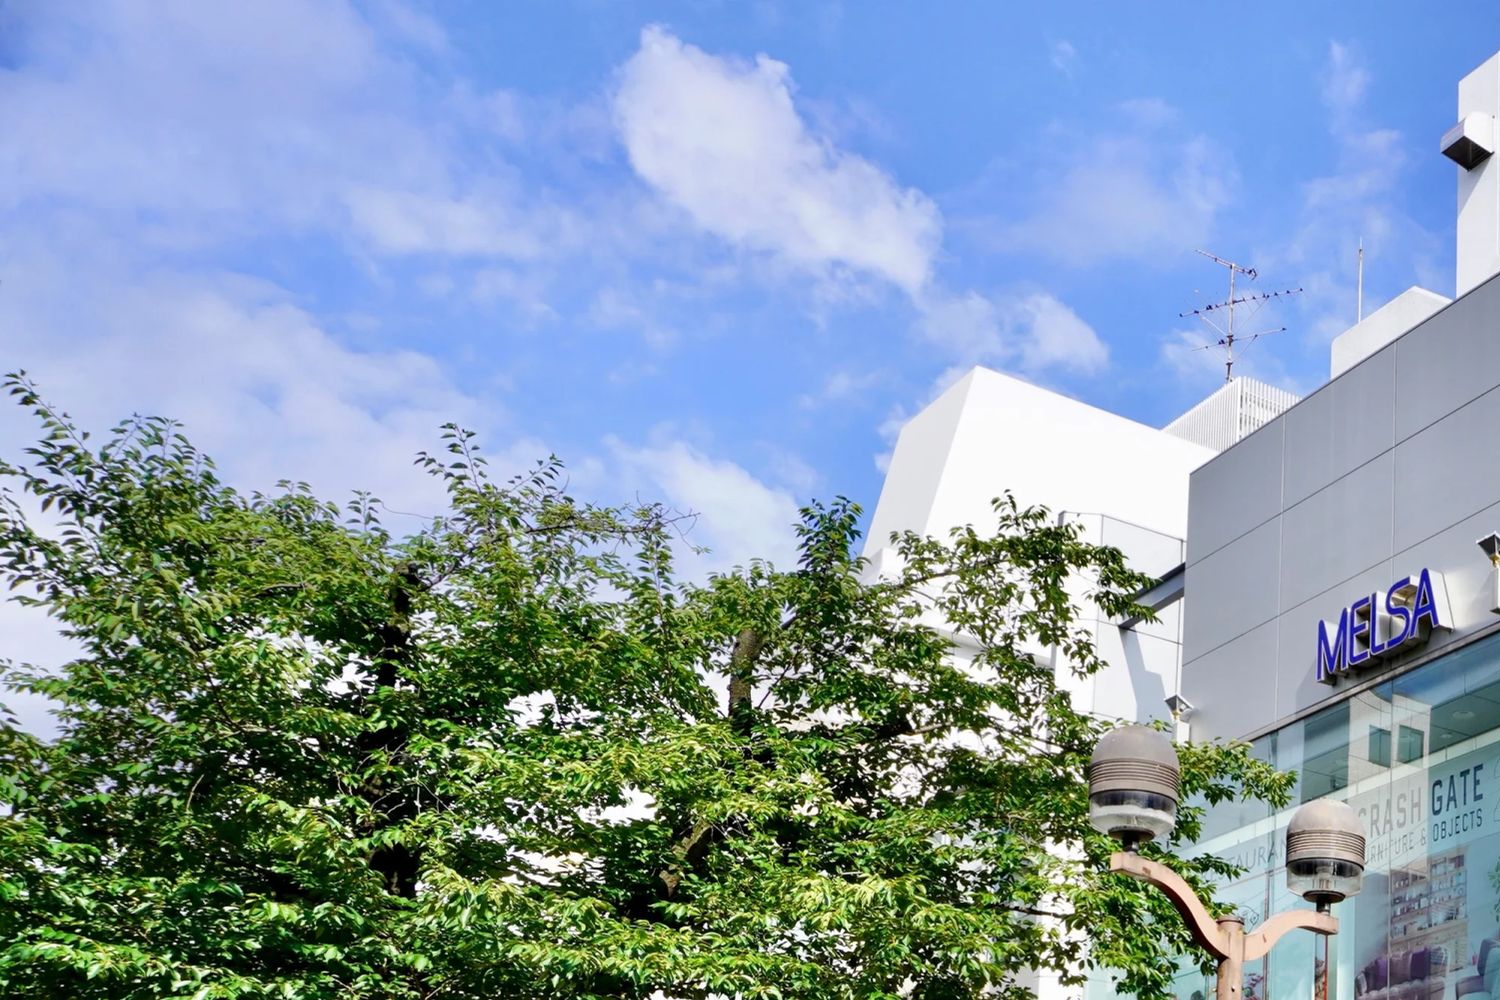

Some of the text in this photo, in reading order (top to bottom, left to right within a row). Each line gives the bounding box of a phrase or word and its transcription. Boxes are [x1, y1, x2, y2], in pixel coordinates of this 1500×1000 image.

[1316, 567, 1440, 682] MELSA
[1430, 763, 1484, 816] GATE
[1365, 831, 1415, 865] RNITURE
[1432, 808, 1483, 842] OBJECTS
